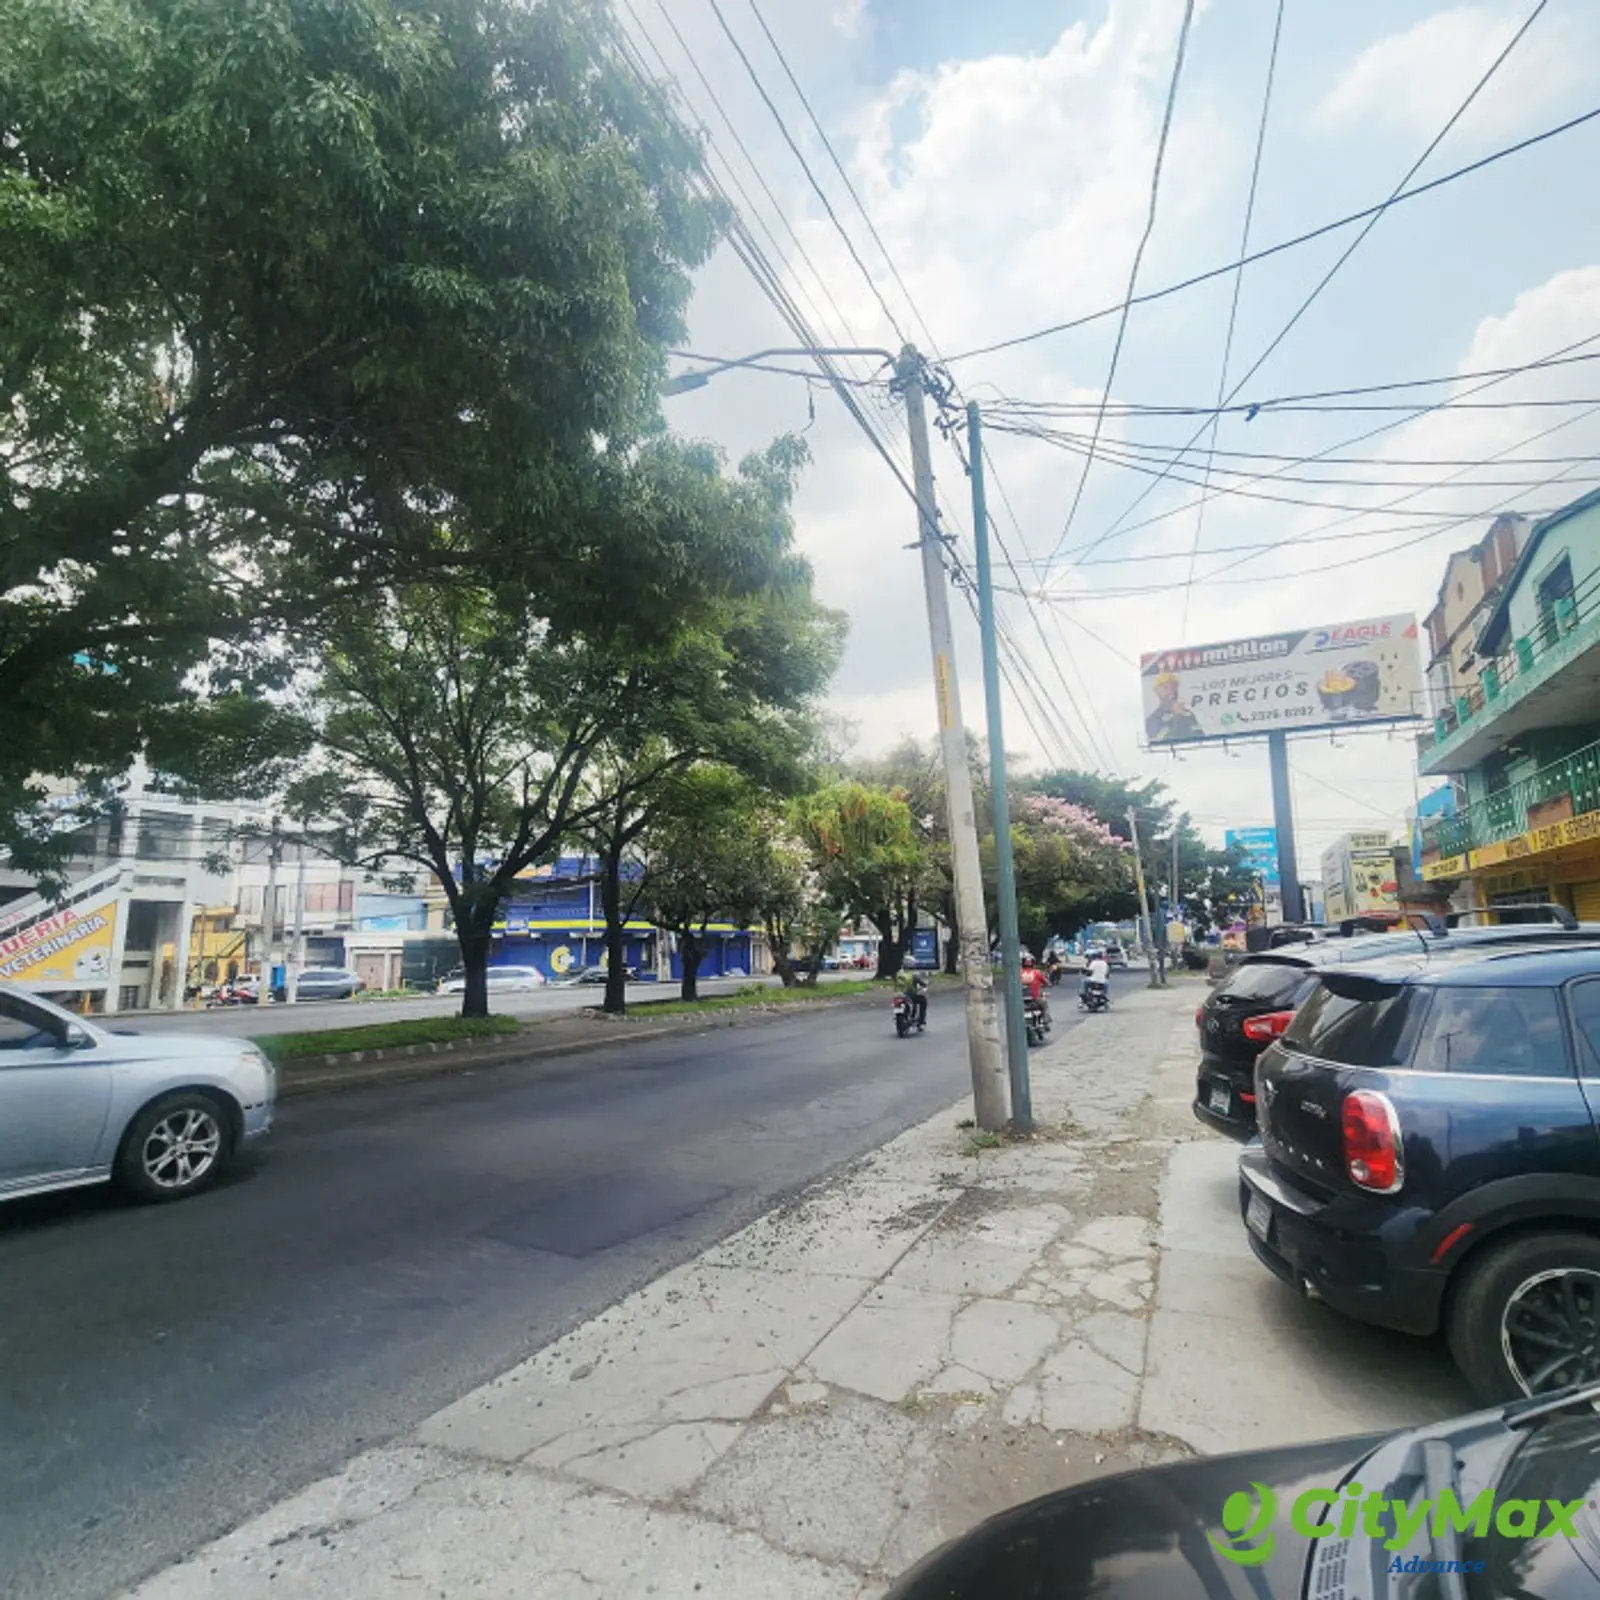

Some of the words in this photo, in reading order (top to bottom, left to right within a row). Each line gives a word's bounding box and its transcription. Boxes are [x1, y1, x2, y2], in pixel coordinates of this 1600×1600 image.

[1331, 621, 1392, 642] EAGLE
[1202, 679, 1226, 691] LOS
[1230, 670, 1294, 687] MEJORES
[1190, 681, 1309, 708] PRECIOS
[0, 910, 79, 960] UERIA
[0, 914, 109, 979] VETERINARIA
